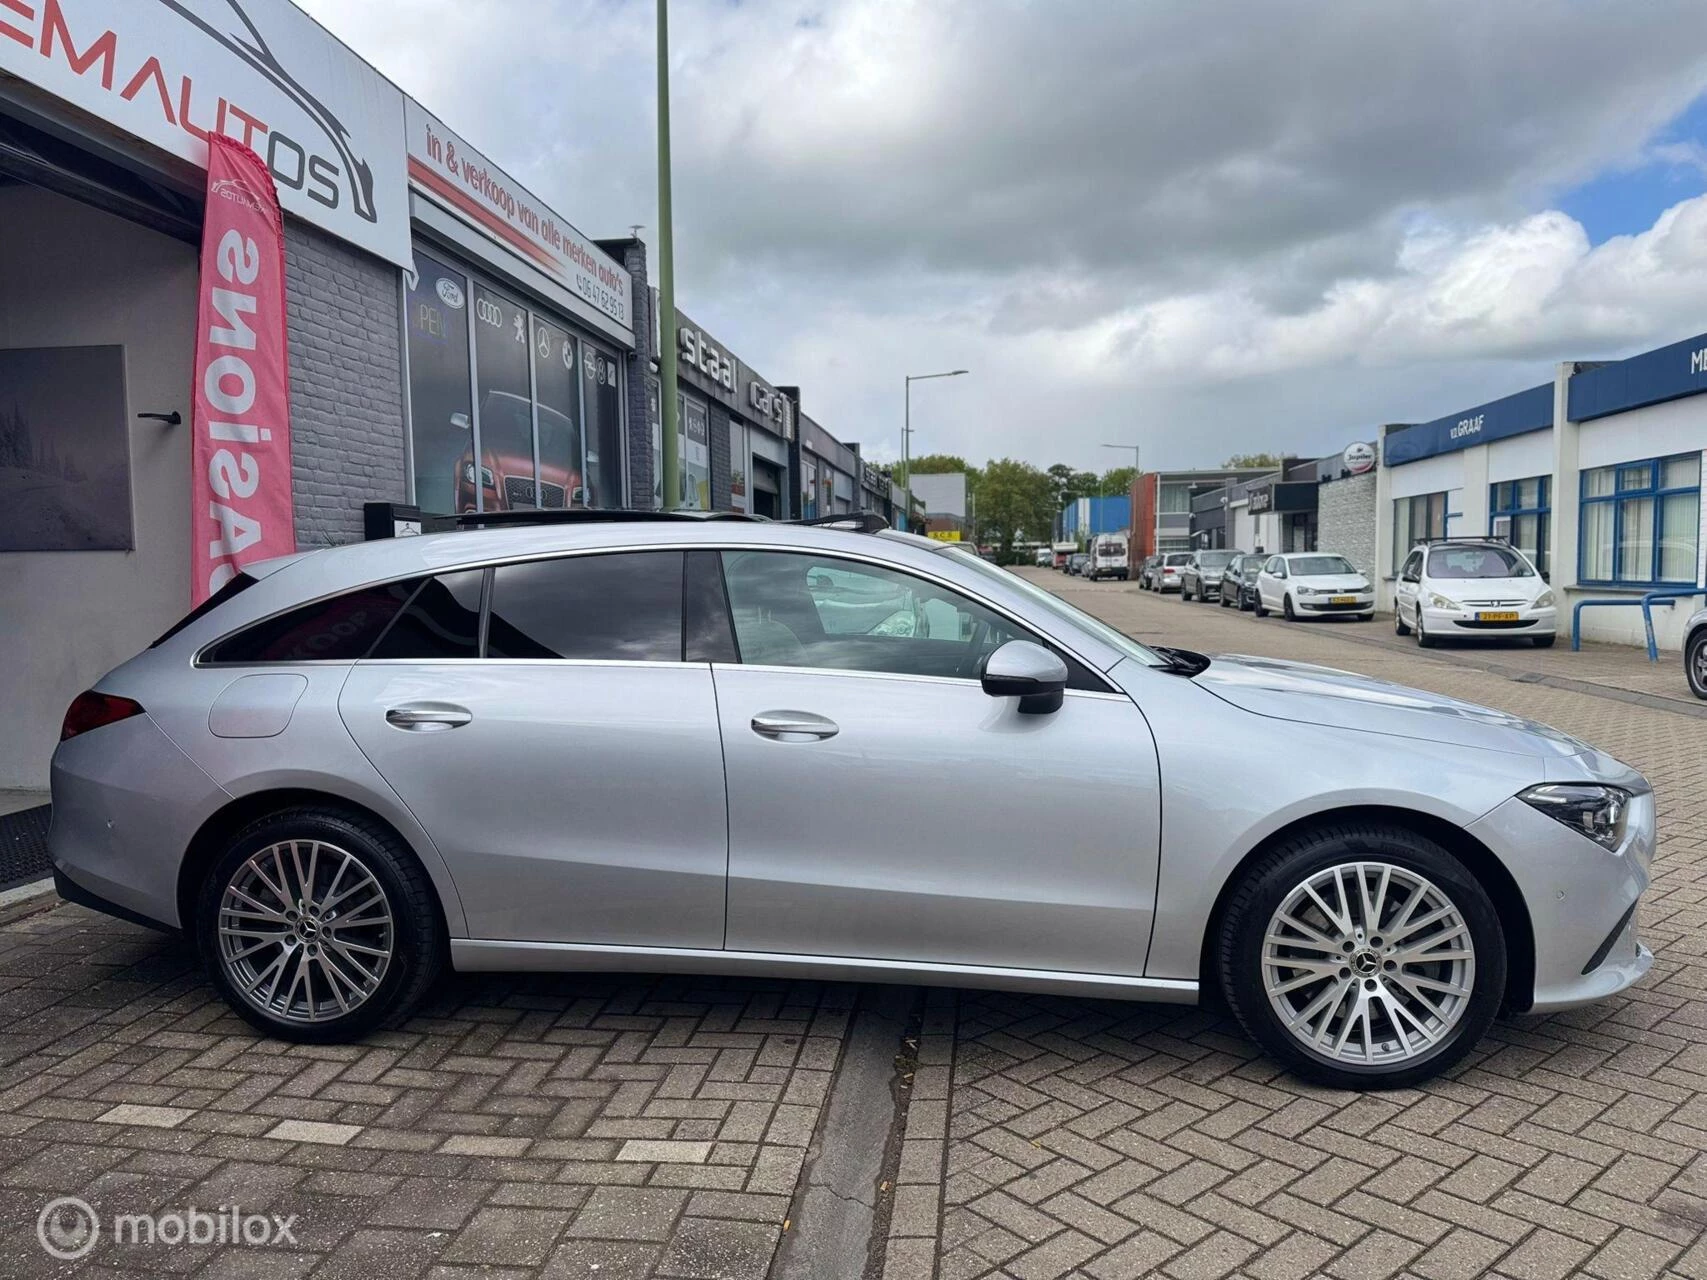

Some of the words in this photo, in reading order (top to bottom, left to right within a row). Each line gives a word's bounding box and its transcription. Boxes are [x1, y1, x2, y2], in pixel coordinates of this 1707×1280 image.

[426, 123, 442, 164] in
[446, 141, 459, 176] &
[461, 157, 515, 219] verkoop
[518, 199, 539, 235] van
[541, 218, 561, 250] alle
[562, 235, 598, 278] merken
[680, 327, 738, 393] staal
[1457, 414, 1485, 437] GRAAF
